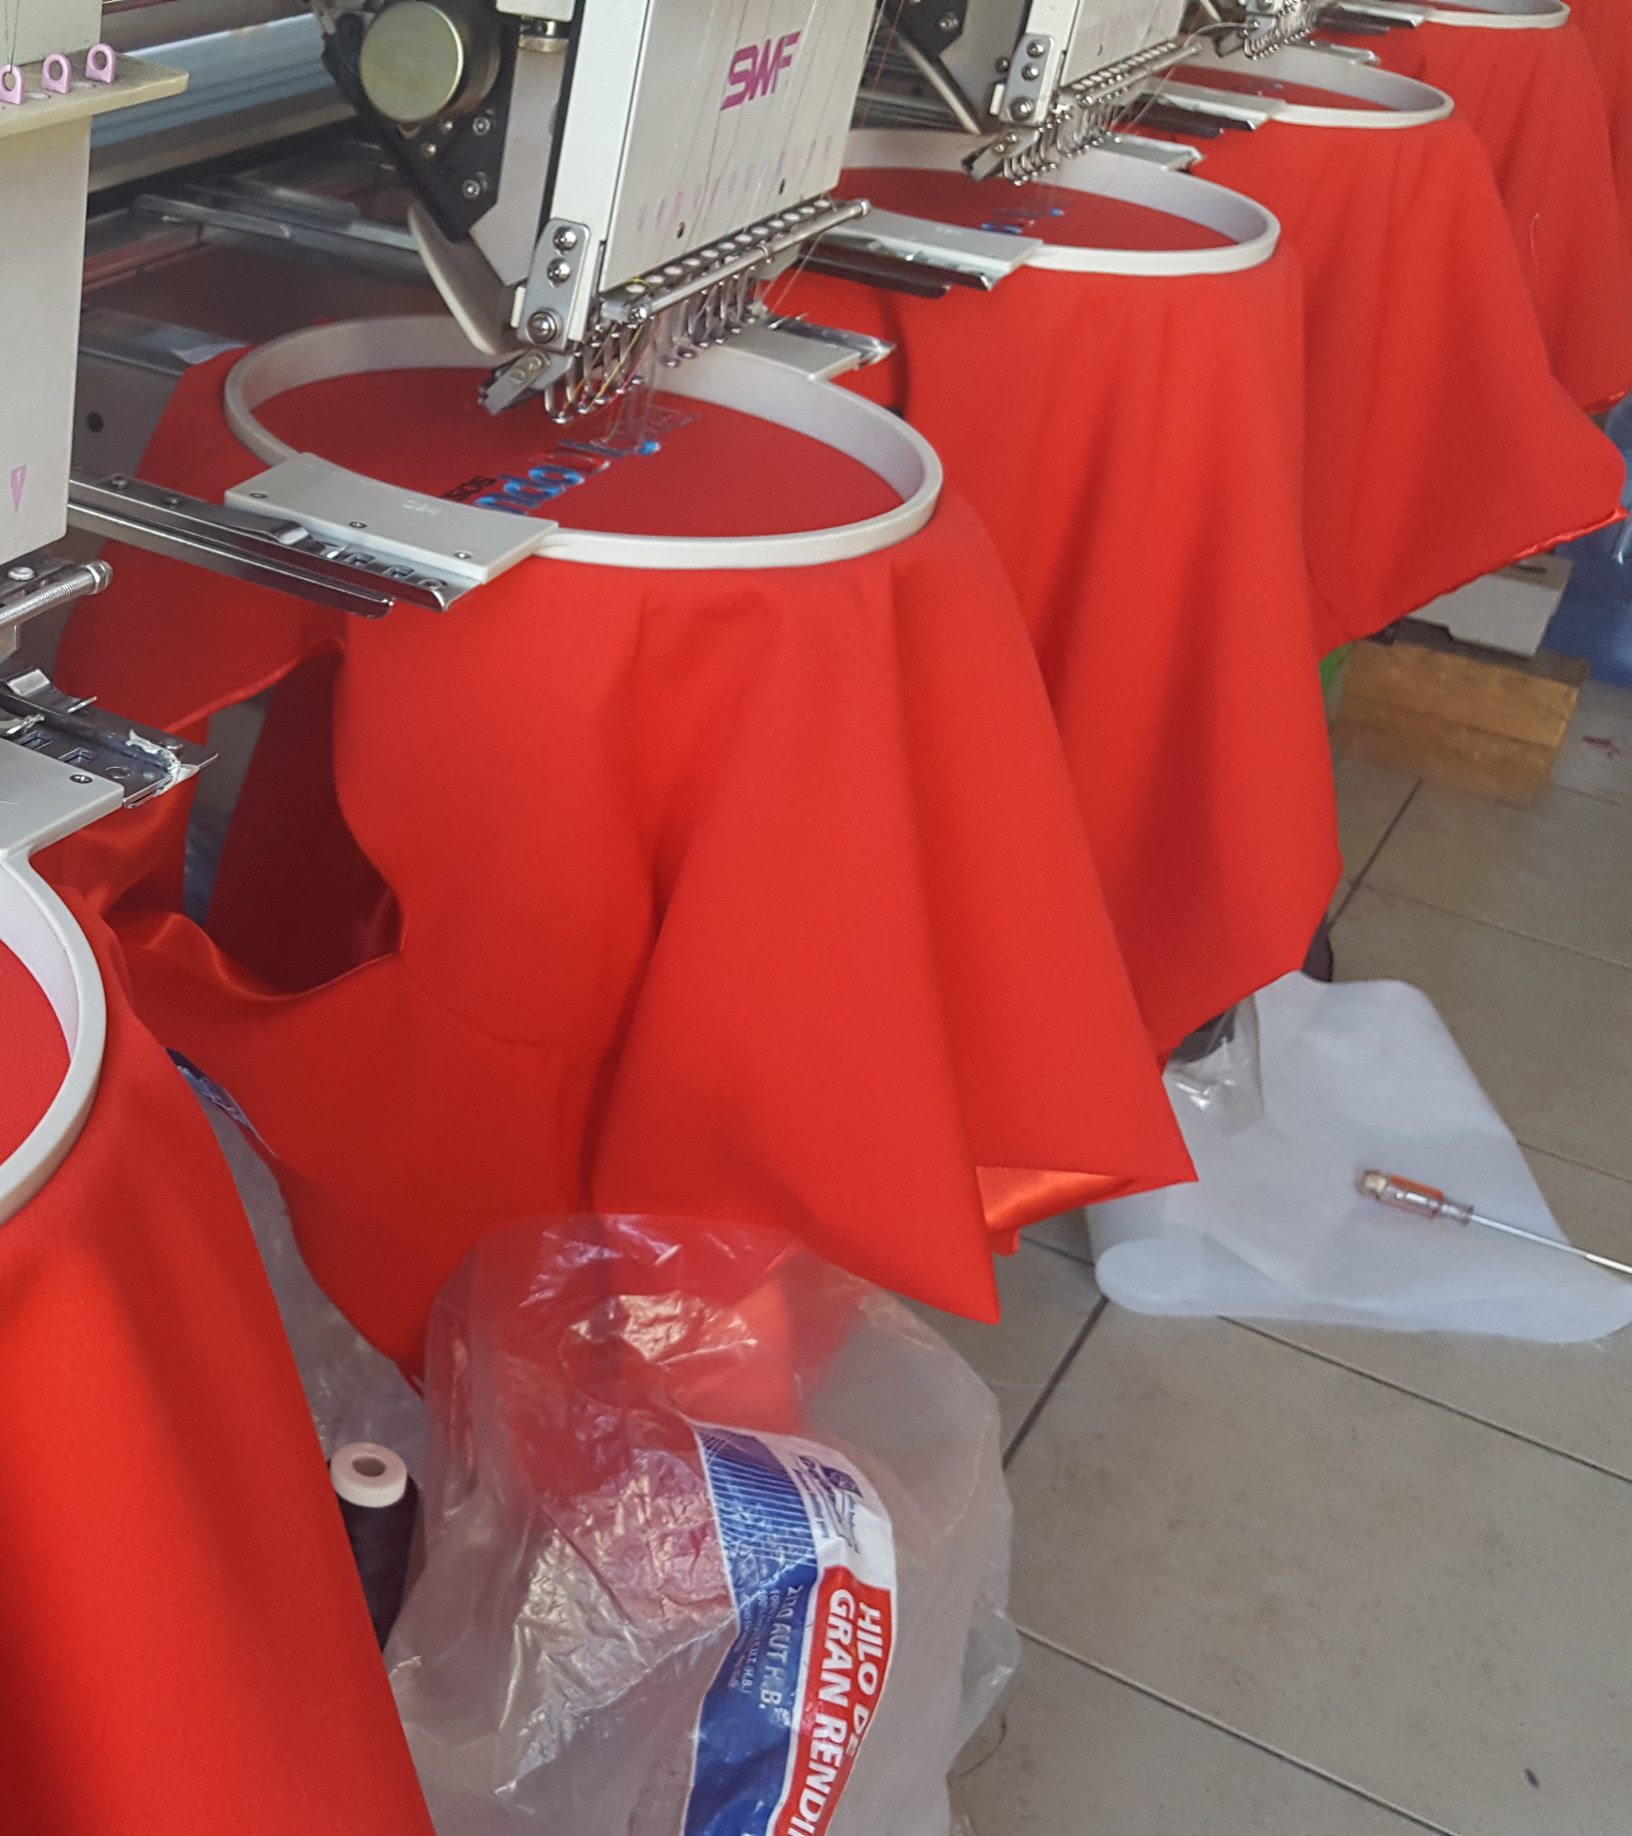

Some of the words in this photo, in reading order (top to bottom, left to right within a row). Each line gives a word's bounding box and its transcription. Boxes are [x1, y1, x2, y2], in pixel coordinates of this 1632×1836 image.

[720, 31, 802, 111] SWF
[818, 1589, 856, 1708] GRAN
[857, 1602, 884, 1695] HILO
[786, 1713, 848, 1836] RENDI
